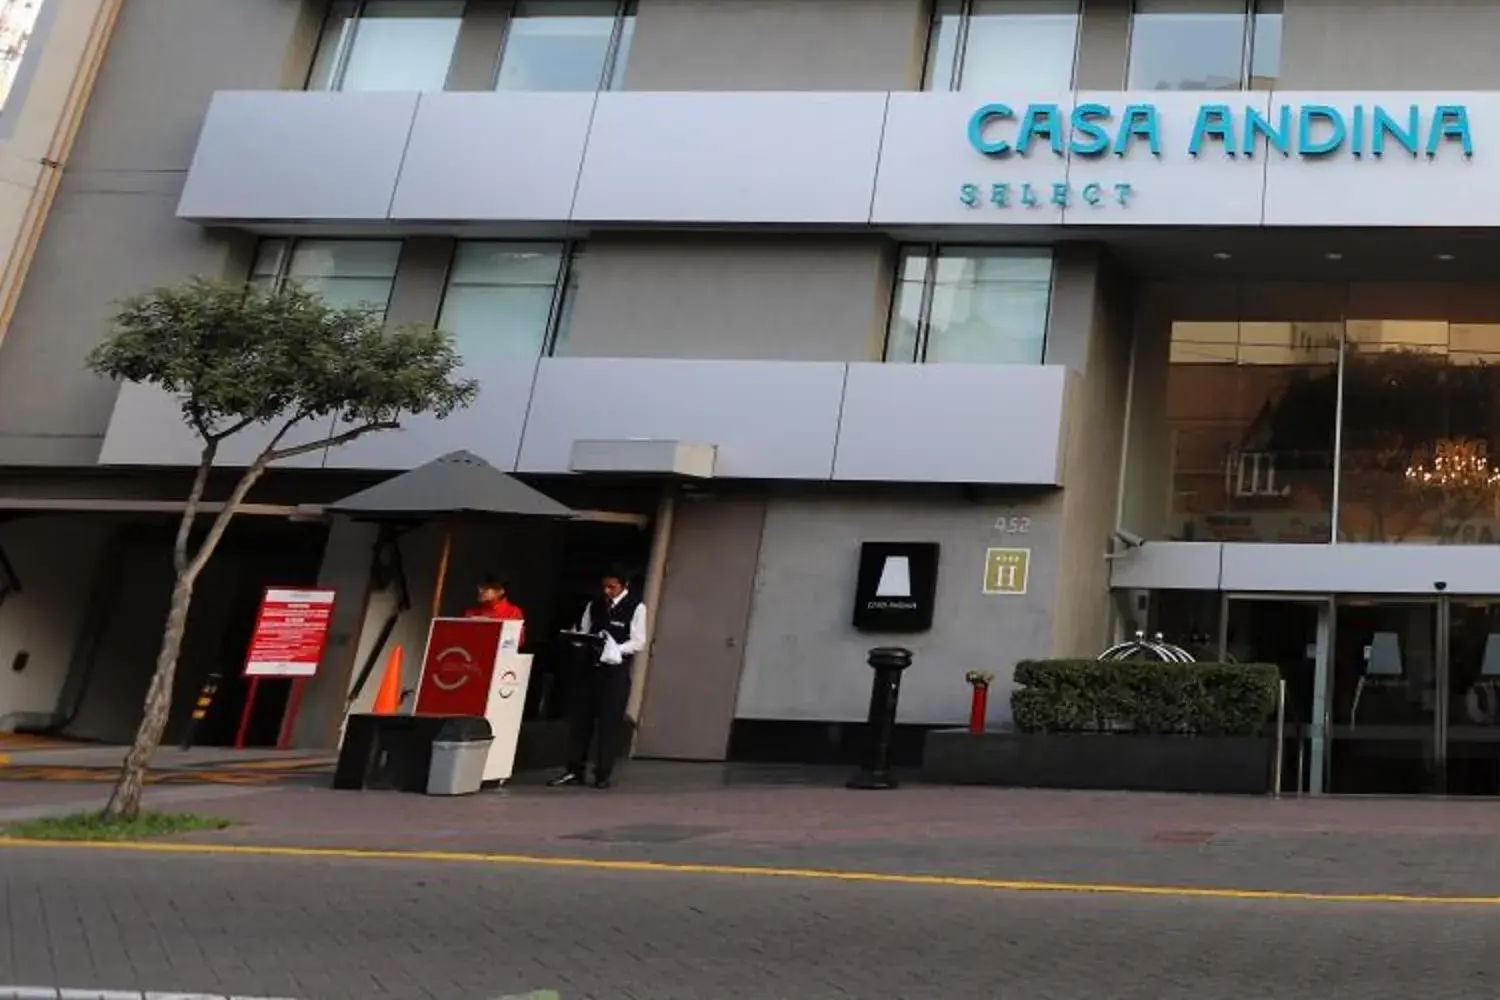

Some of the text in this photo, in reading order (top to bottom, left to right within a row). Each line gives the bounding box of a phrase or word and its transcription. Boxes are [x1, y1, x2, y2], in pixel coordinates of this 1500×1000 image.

[967, 103, 1474, 159] CASA ANDINA
[959, 183, 1134, 208] SELECT
[994, 516, 1031, 533] 452
